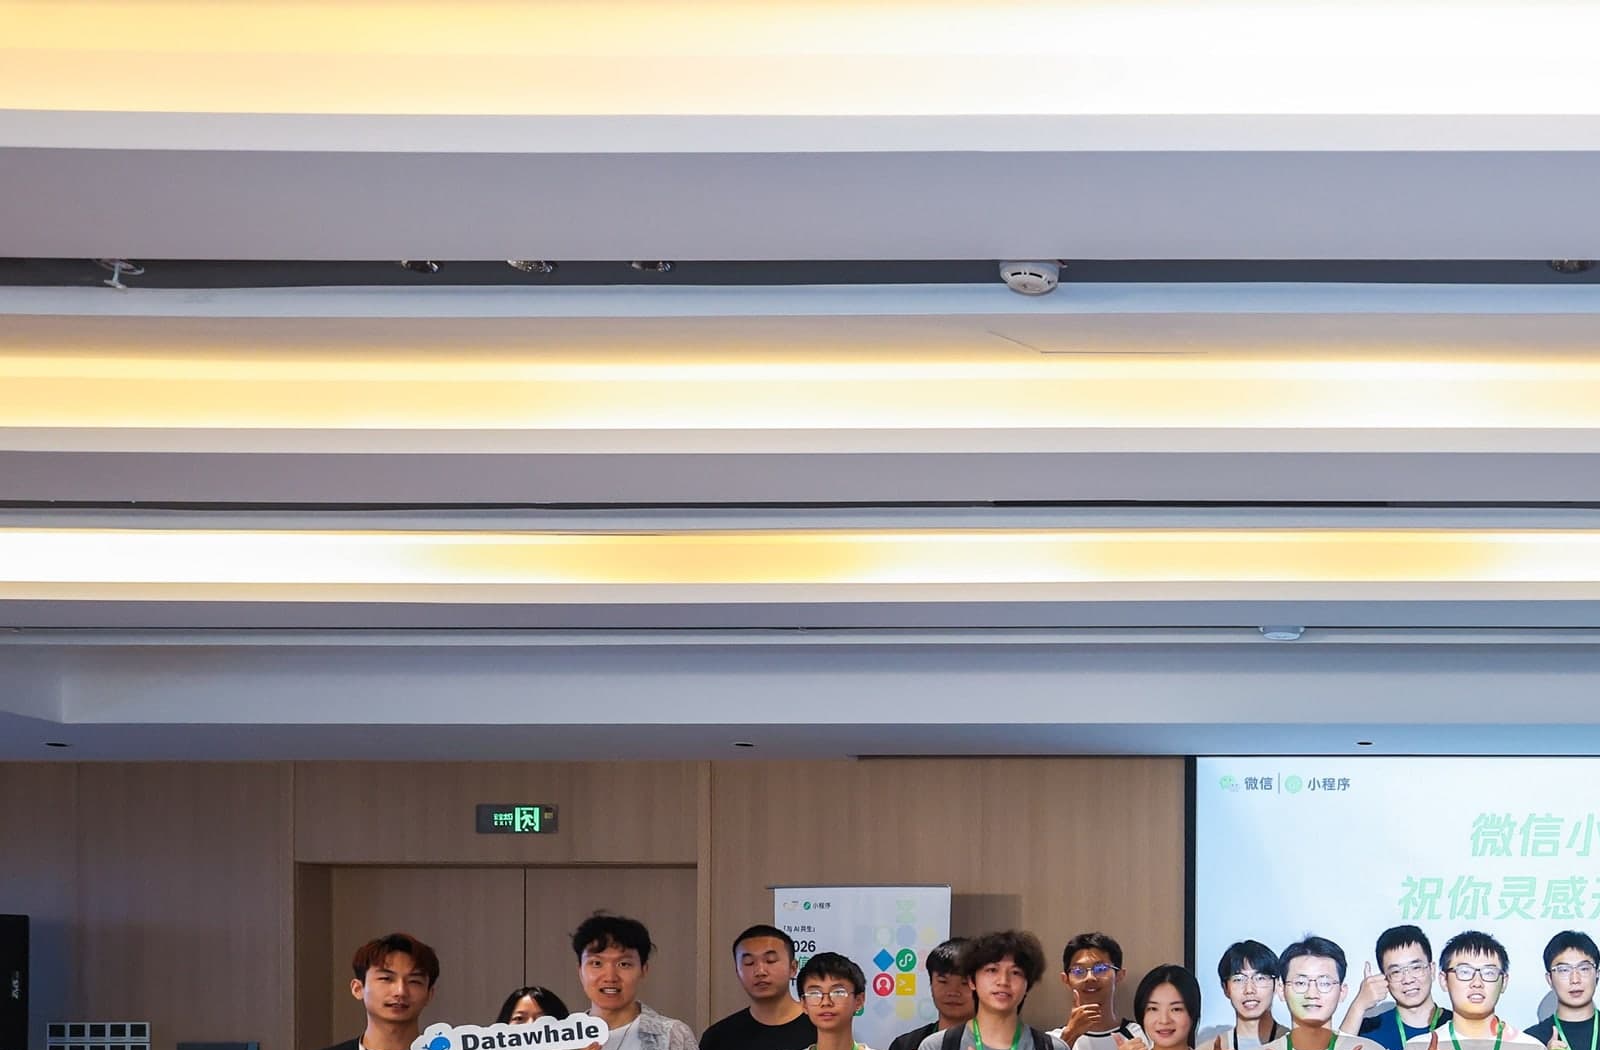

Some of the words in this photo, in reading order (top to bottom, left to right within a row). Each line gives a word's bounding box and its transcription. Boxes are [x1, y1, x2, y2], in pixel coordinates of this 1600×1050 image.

[1244, 776, 1273, 791] 微信
[1307, 777, 1351, 792] 小程序
[793, 940, 816, 953] 026
[461, 1022, 599, 1050] Datawhale
